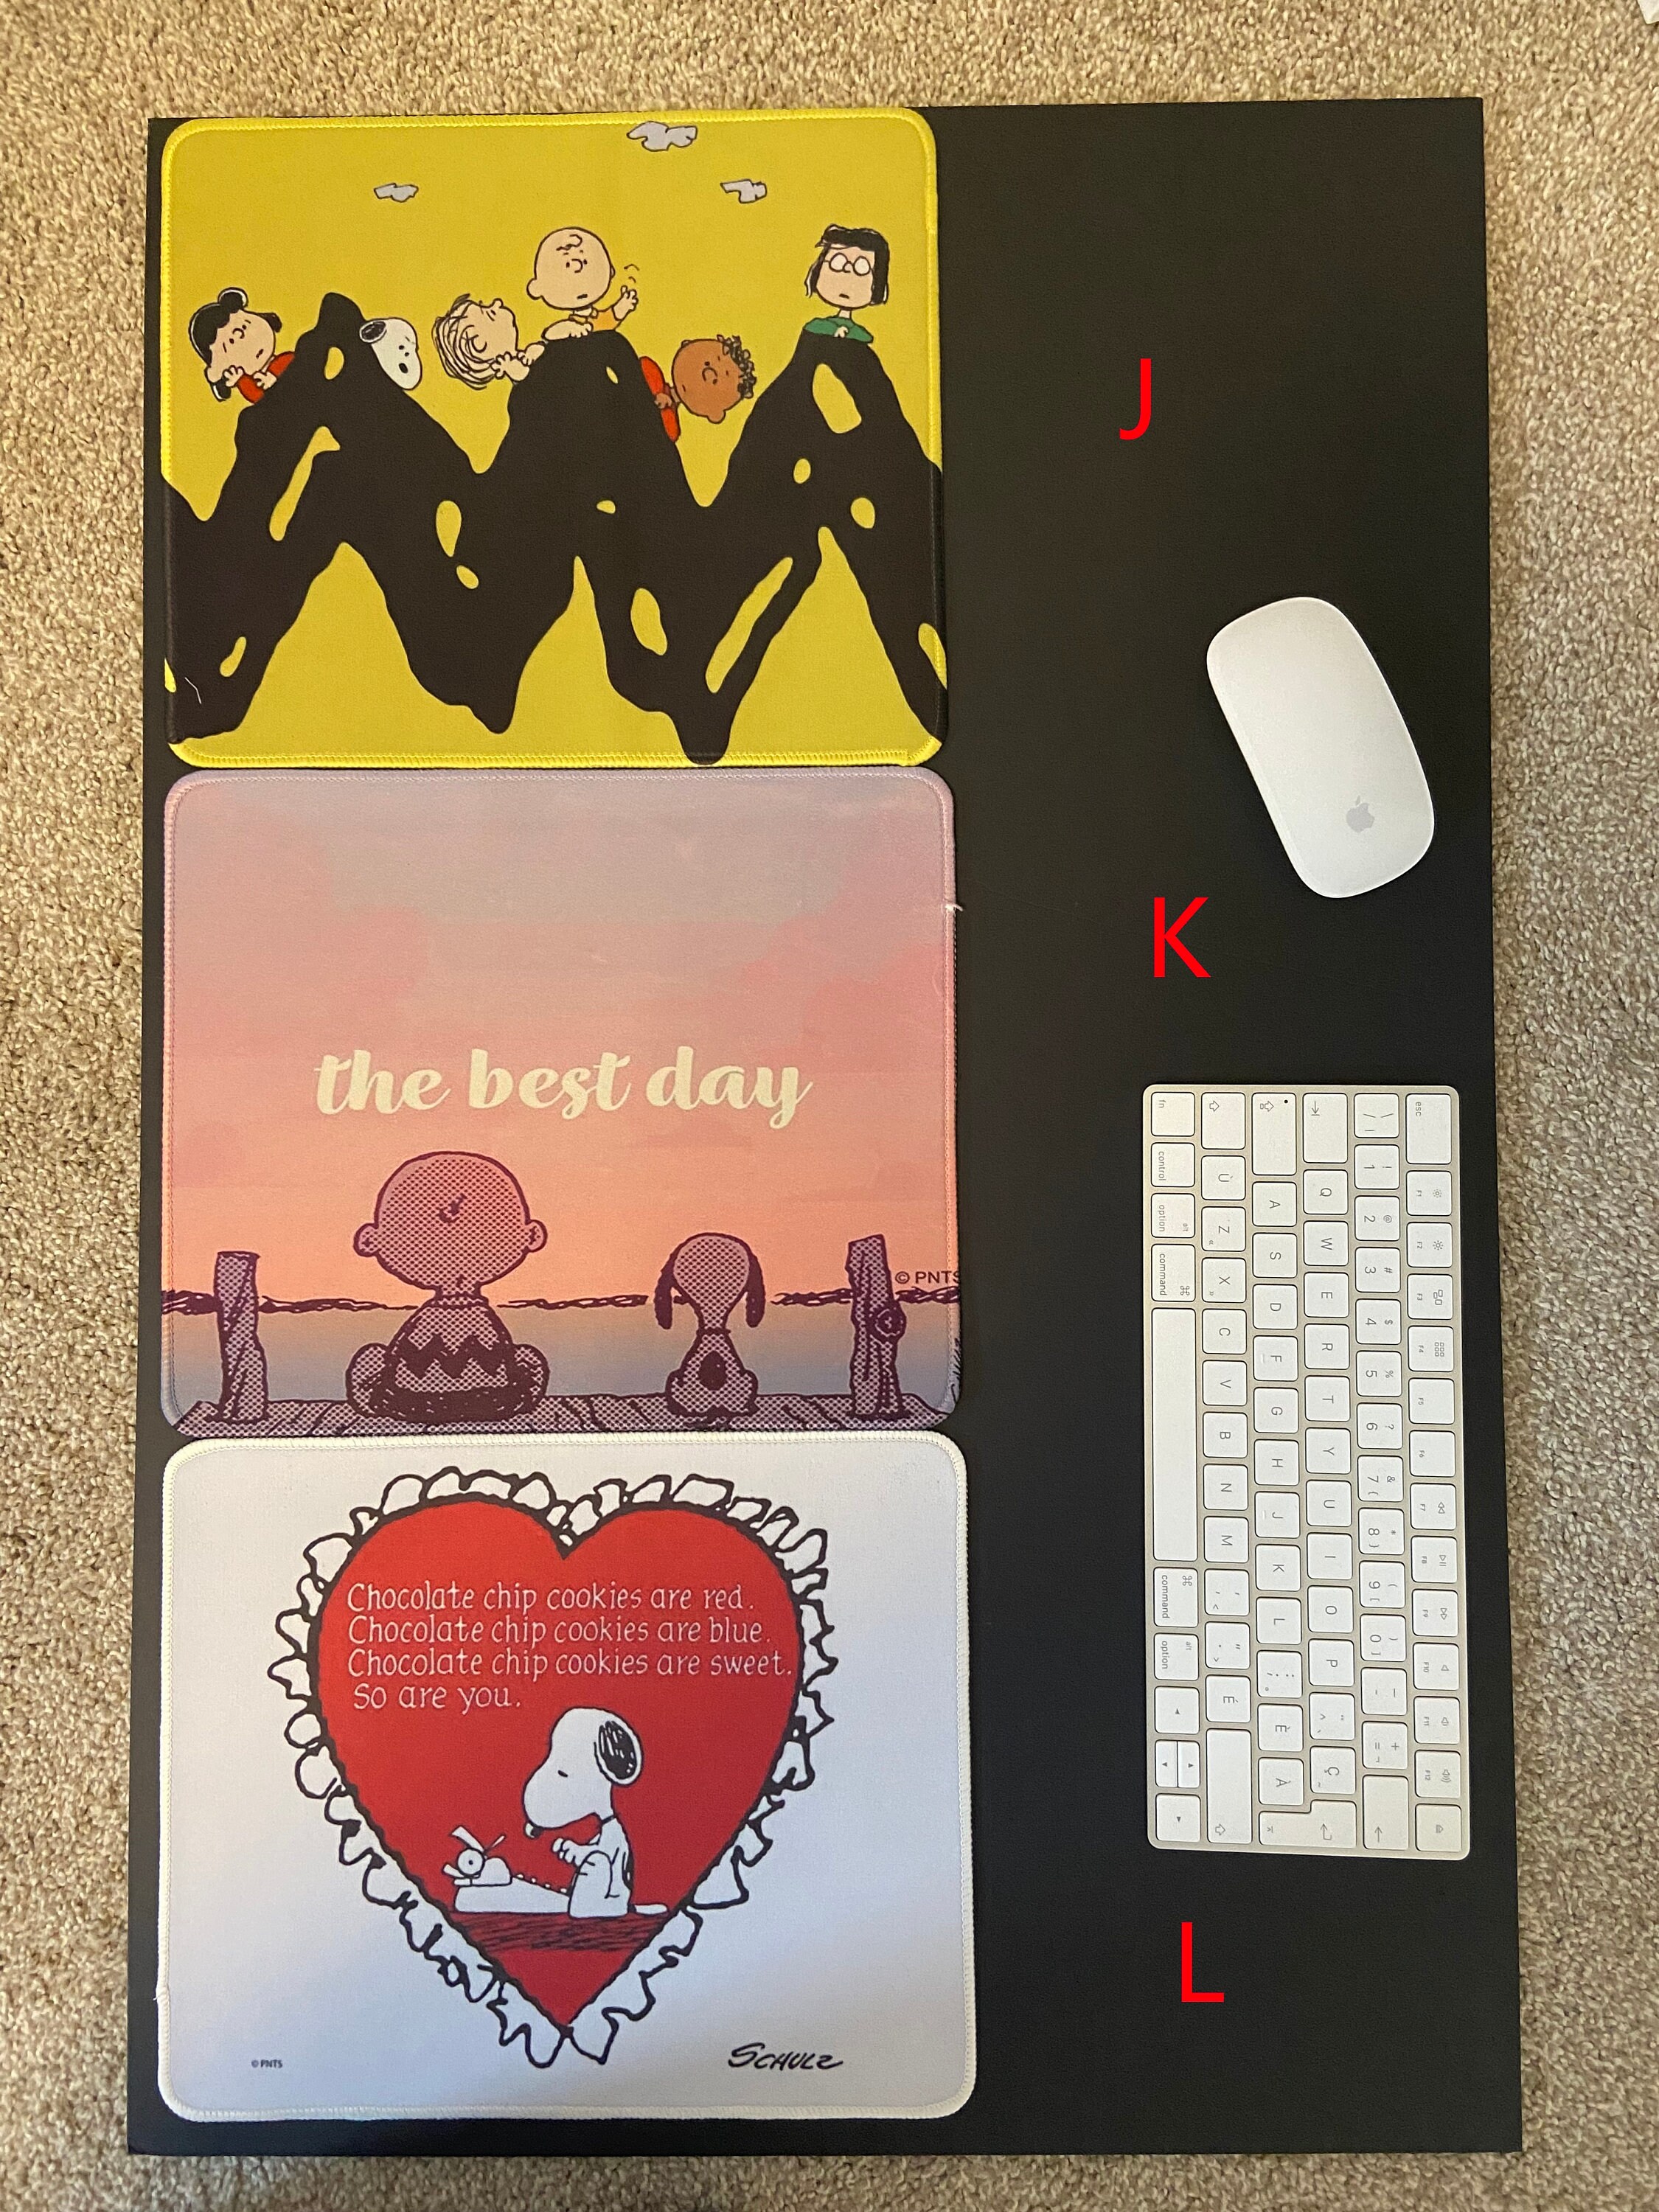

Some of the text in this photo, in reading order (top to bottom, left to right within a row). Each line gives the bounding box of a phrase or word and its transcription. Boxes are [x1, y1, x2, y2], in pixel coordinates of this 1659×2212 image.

[315, 1046, 813, 1129] the best day
[1158, 1099, 1166, 1108] fn
[1158, 1151, 1166, 1181] control
[1217, 1173, 1234, 1183] Ù
[1319, 1187, 1332, 1197] Q
[1269, 1200, 1281, 1209] A
[1157, 1204, 1167, 1232] option
[1218, 1225, 1230, 1234] Z
[1321, 1237, 1333, 1251] W
[1416, 1241, 1423, 1249] F2
[1269, 1251, 1281, 1260] S
[1159, 1253, 1168, 1295] command
[1364, 1266, 1377, 1274] 3
[1218, 1276, 1231, 1285] X
[1321, 1291, 1333, 1299] E
[1416, 1293, 1423, 1301] F3
[1270, 1303, 1281, 1312] D
[1365, 1318, 1377, 1326] 4
[1219, 1327, 1231, 1337] C
[1321, 1343, 1334, 1352] R
[1418, 1345, 1425, 1353] F4
[1365, 1369, 1377, 1378] 5
[1220, 1380, 1231, 1389] V
[1322, 1395, 1334, 1404] T
[1418, 1397, 1425, 1405] F5
[1270, 1406, 1283, 1416] G
[1366, 1422, 1378, 1430] 6
[1219, 1431, 1231, 1440] B
[1323, 1447, 1335, 1456] Y
[1419, 1450, 1425, 1458] F6
[1271, 1458, 1284, 1468] H
[1367, 1475, 1379, 1484] 7
[1220, 1483, 1232, 1492] N
[1323, 1499, 1335, 1509] U
[1419, 1503, 1426, 1512] F7
[1368, 1527, 1380, 1536] 8
[1221, 1535, 1233, 1546] M
[1421, 1556, 1427, 1565] F8
[1273, 1564, 1284, 1573] K
[1368, 1581, 1381, 1590] 9
[347, 1581, 754, 1615] Chocolate chip cookies are red.
[1161, 1574, 1170, 1618] command
[1325, 1605, 1338, 1615] O
[1422, 1609, 1429, 1618] F9
[348, 1614, 771, 1648] Chocolate chip cookies are blue.
[1369, 1634, 1382, 1643] 0
[1161, 1641, 1170, 1669] option
[348, 1648, 792, 1682] Chocolate chip cookies are sweet.
[1326, 1659, 1338, 1668] P
[354, 1683, 521, 1715] So are you.
[1222, 1696, 1239, 1704] É
[1275, 1725, 1291, 1733] È
[1324, 1767, 1340, 1776] Ç
[1276, 1778, 1291, 1787] À
